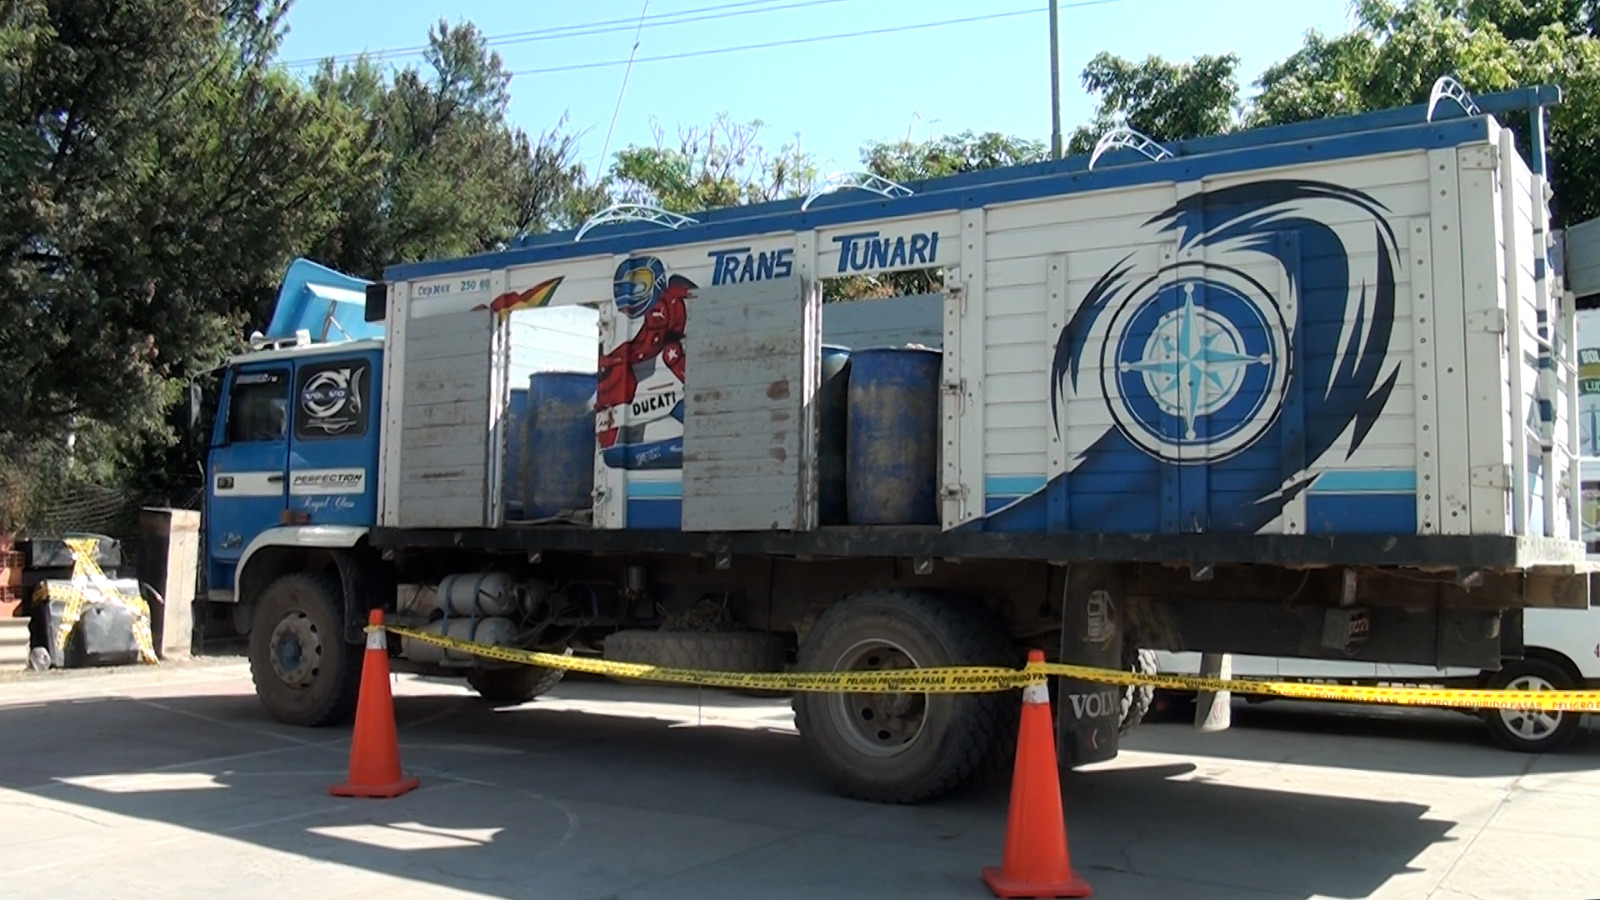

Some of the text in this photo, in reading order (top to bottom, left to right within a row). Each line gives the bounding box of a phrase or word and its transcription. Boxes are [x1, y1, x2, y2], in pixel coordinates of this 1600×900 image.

[708, 231, 939, 285] TRANS TUNARI
[304, 390, 346, 400] VOVO
[633, 391, 676, 416] DUCATI
[294, 474, 362, 484] PERFECTION
[846, 677, 876, 685] PELIGRO
[920, 676, 946, 684] PASAR
[952, 675, 986, 684] PELIGRO
[1068, 690, 1120, 720] VOLV
[1552, 701, 1594, 710] PELIGRO
